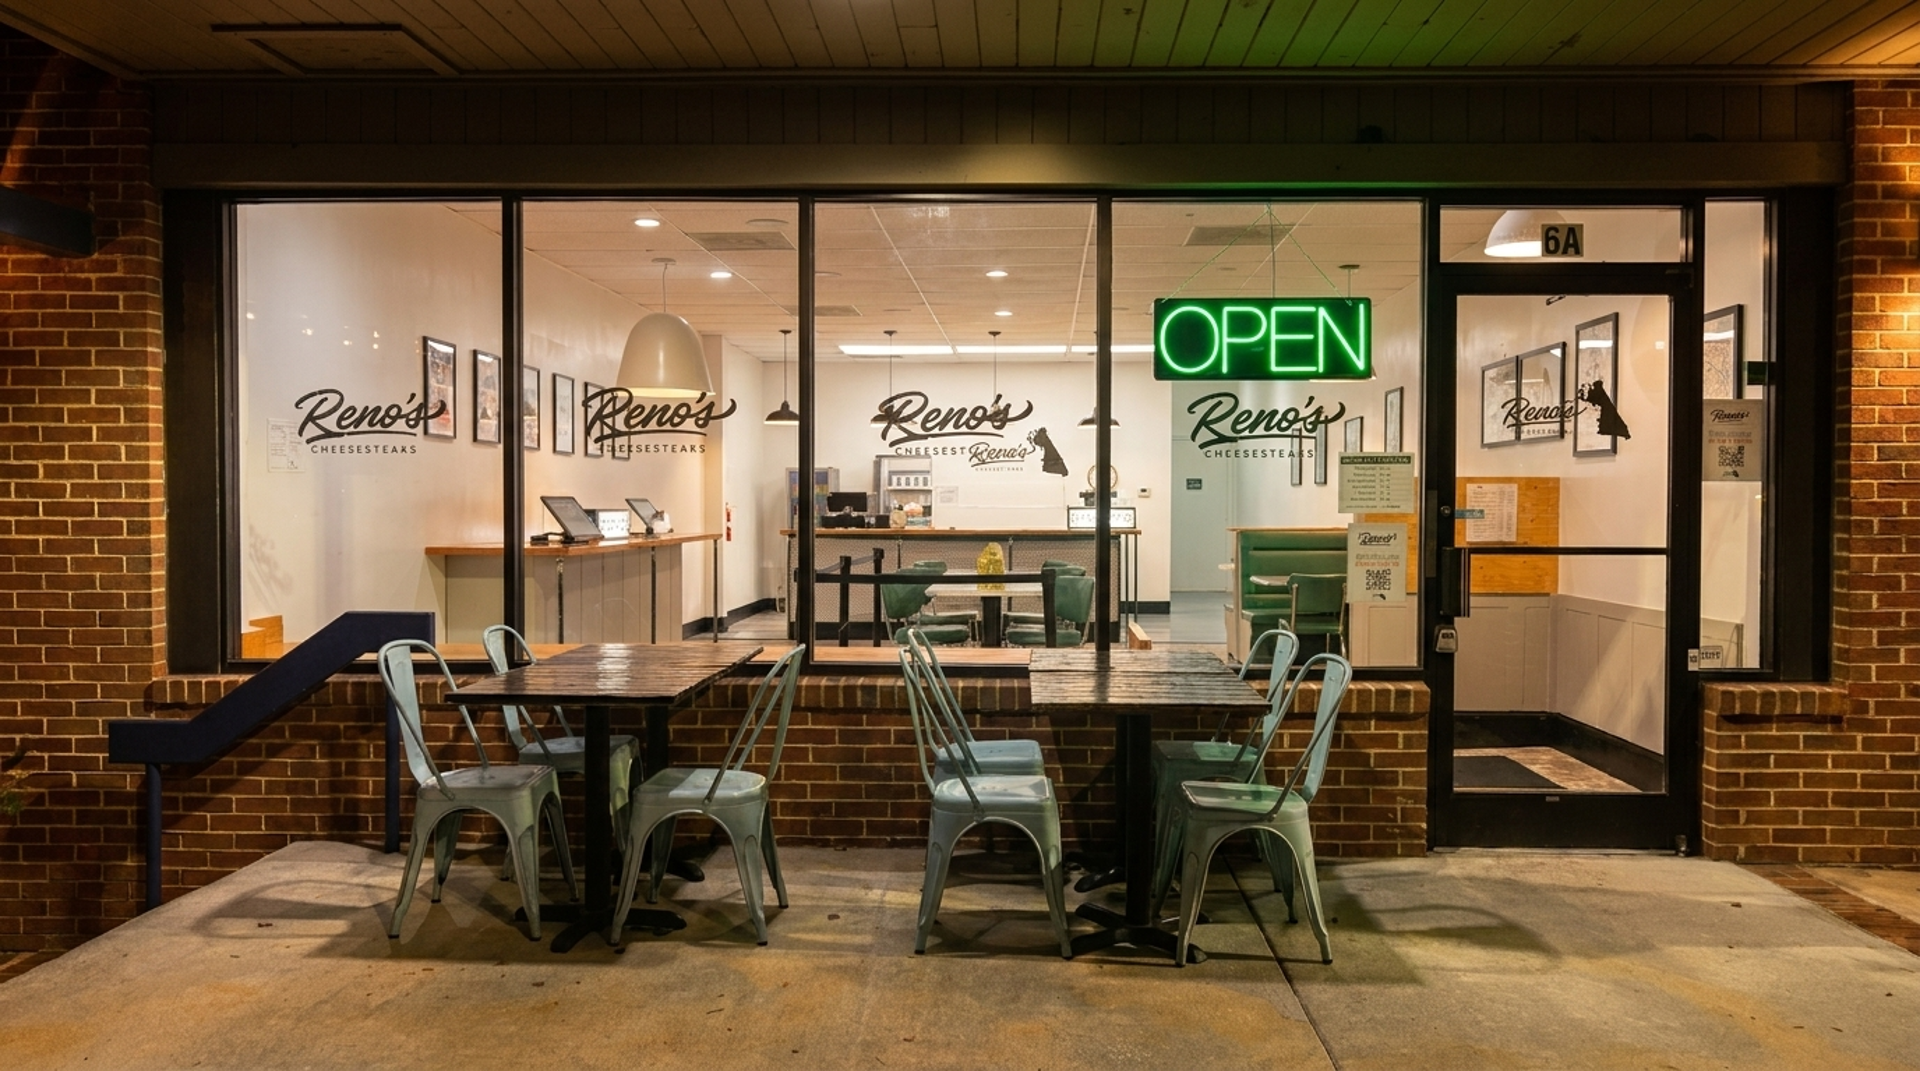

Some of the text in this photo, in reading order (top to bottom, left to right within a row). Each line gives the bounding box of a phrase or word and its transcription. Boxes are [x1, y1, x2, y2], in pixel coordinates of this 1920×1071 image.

[1545, 226, 1580, 255] 6A
[1160, 303, 1365, 374] OPEN
[294, 388, 447, 444] Reno's
[581, 387, 737, 444] Reno's
[878, 391, 1033, 447] Reno's
[1187, 392, 1346, 449] Reno's
